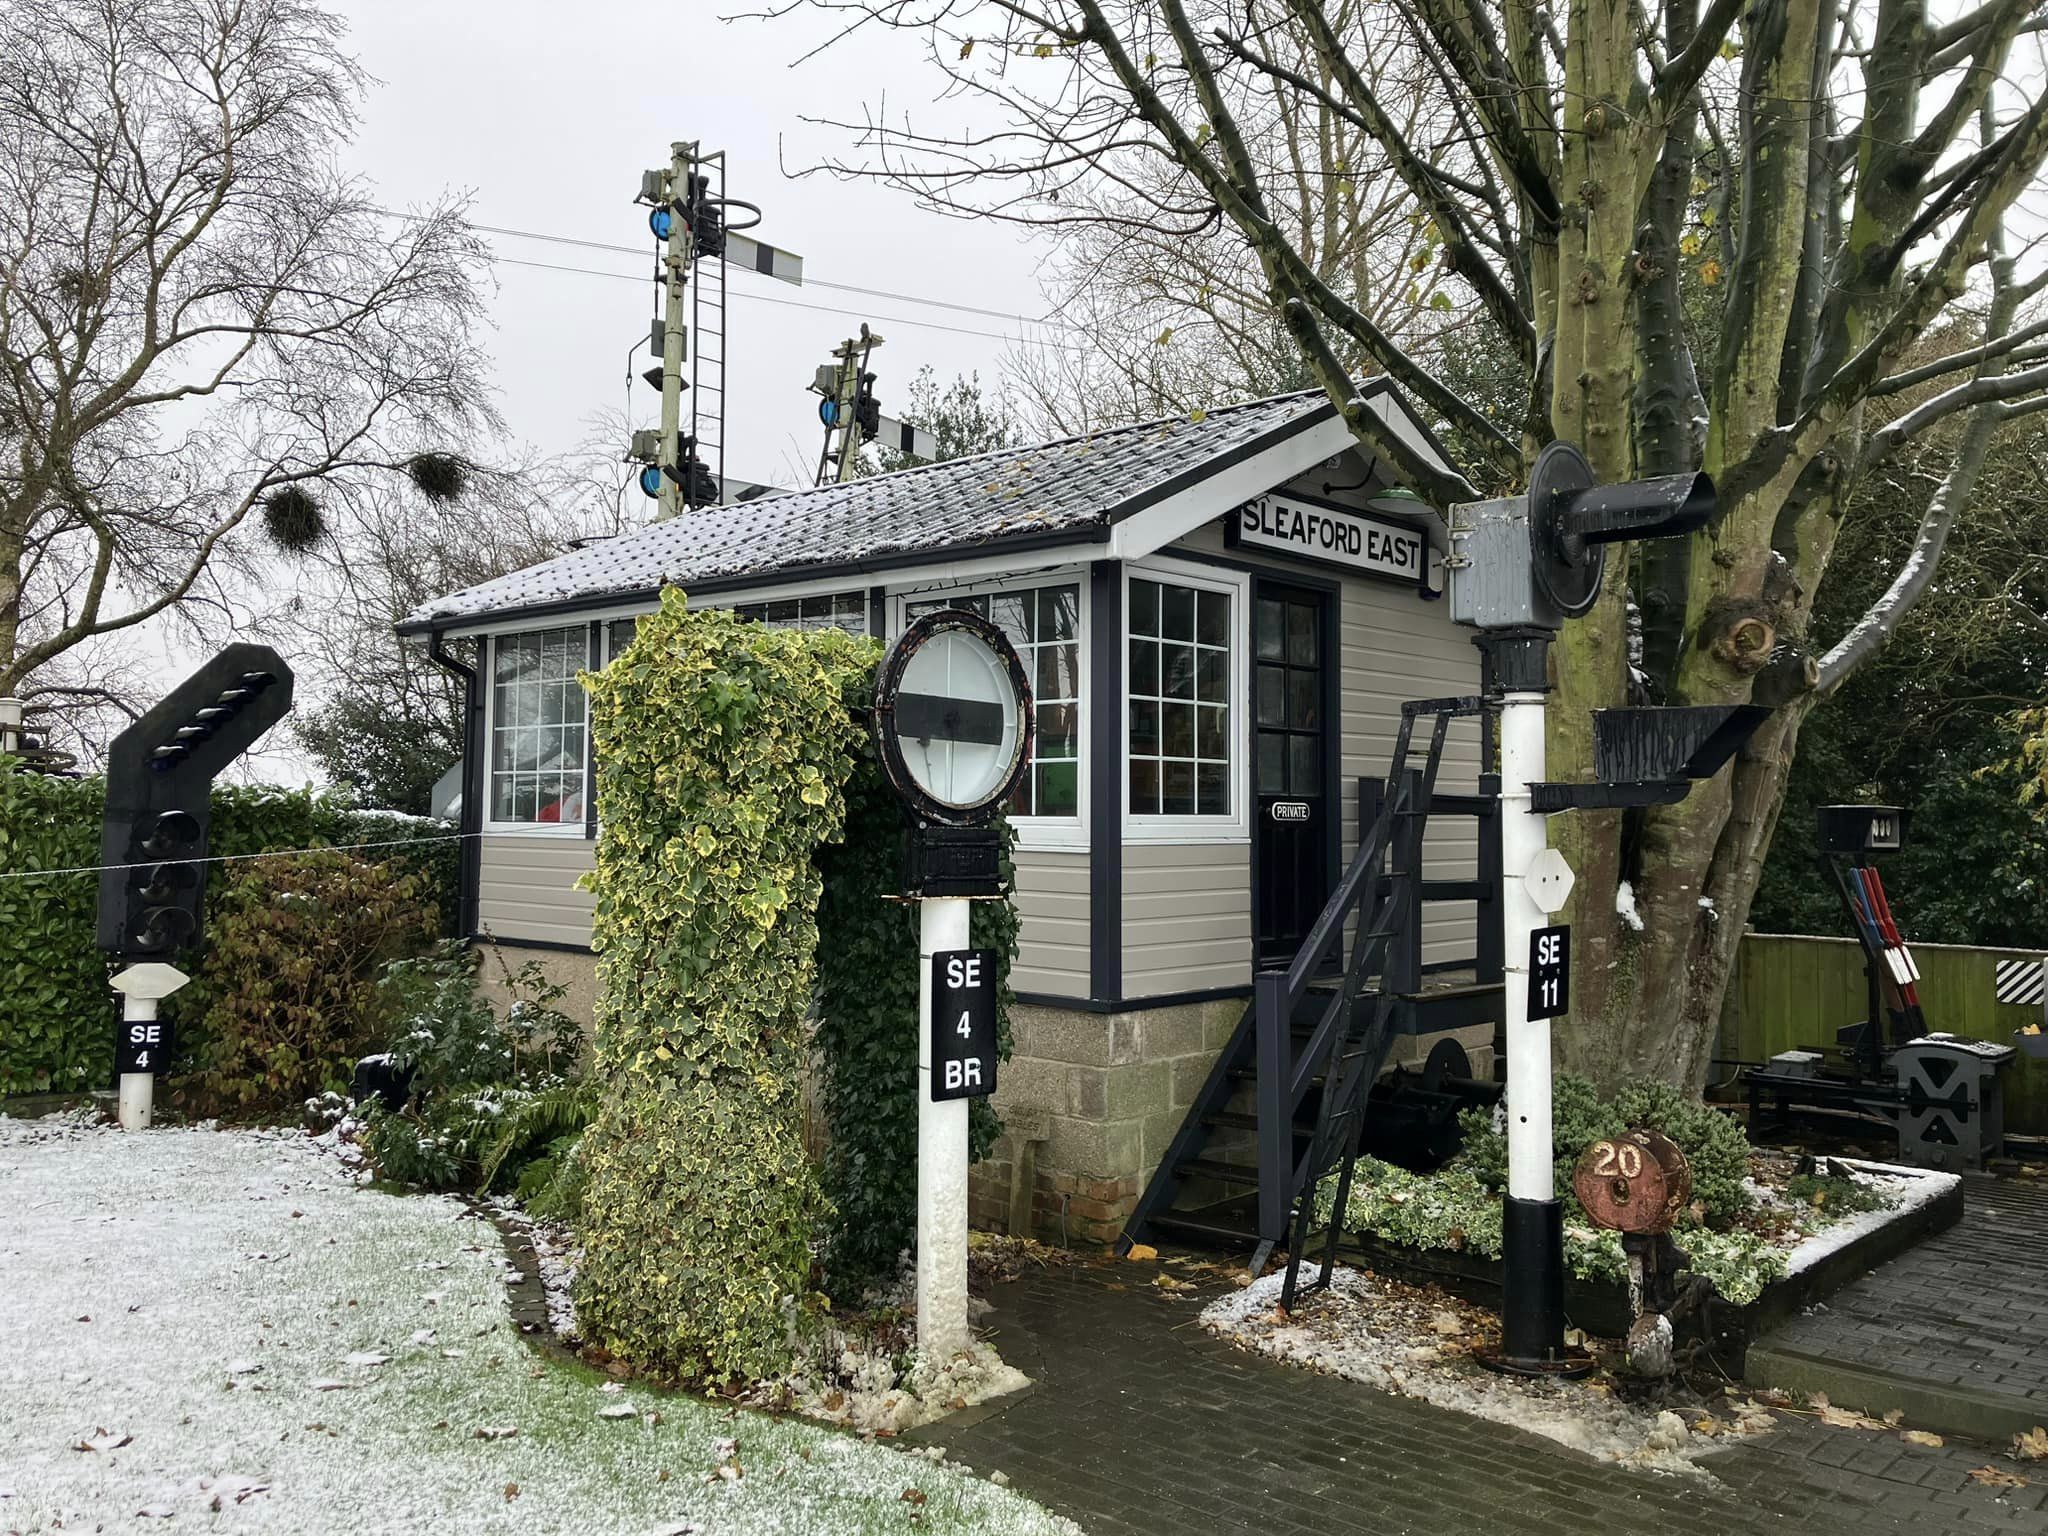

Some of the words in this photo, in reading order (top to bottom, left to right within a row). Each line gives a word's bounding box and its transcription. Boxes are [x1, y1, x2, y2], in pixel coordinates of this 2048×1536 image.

[1243, 498, 1361, 556] SLEAFORD
[1368, 529, 1419, 569] EAST
[1276, 805, 1307, 818] PRIVATE
[1538, 934, 1561, 966] SE
[946, 958, 981, 989] SE
[1541, 978, 1558, 1008] 11
[129, 1025, 161, 1043] SE
[956, 1010, 972, 1039] 4
[135, 1050, 149, 1068] 4
[945, 1057, 982, 1090] BR
[1593, 1140, 1642, 1178] 20
